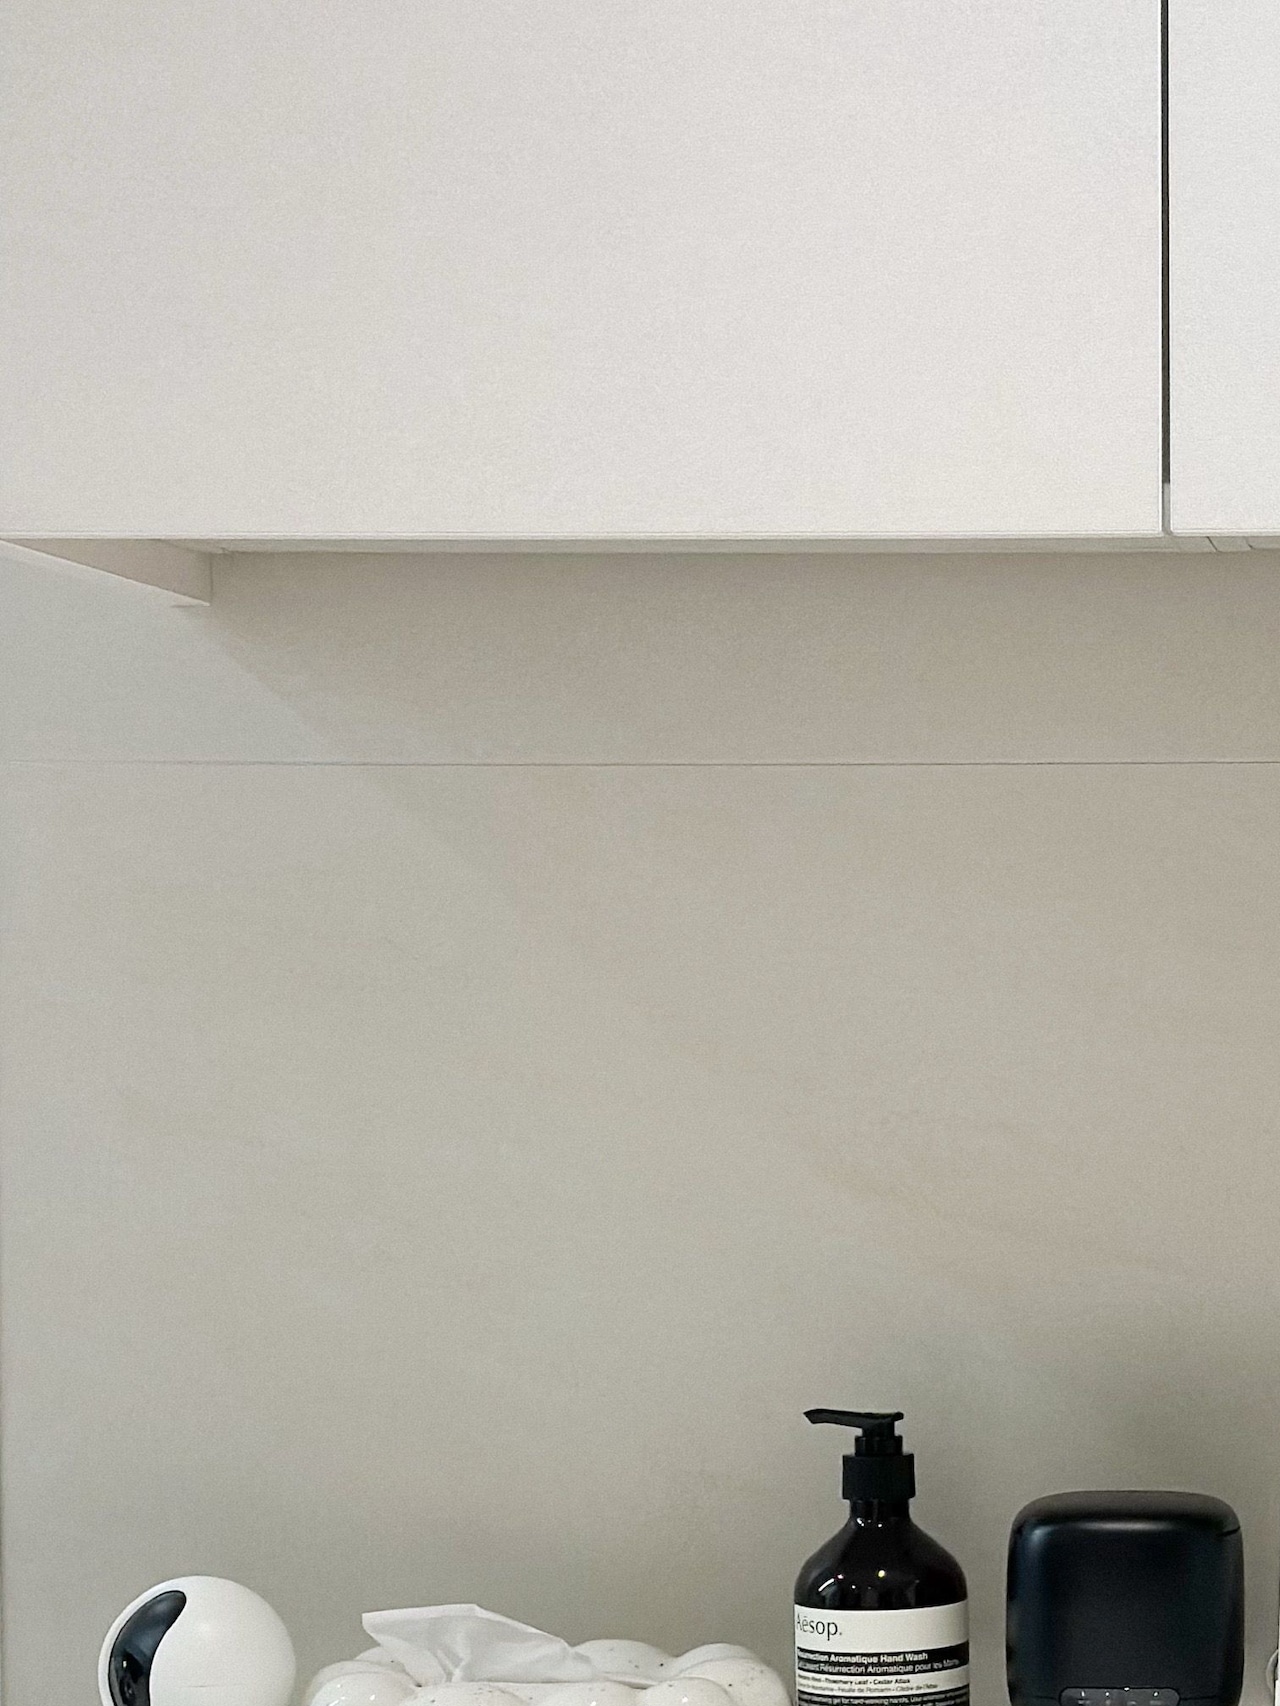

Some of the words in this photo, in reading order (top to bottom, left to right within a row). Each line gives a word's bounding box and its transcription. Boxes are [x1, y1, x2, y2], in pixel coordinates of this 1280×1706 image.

[830, 1653, 879, 1664] Aromatique
[880, 1653, 904, 1663] Hand
[905, 1652, 928, 1662] Wash
[867, 1664, 914, 1674] Aromatique
